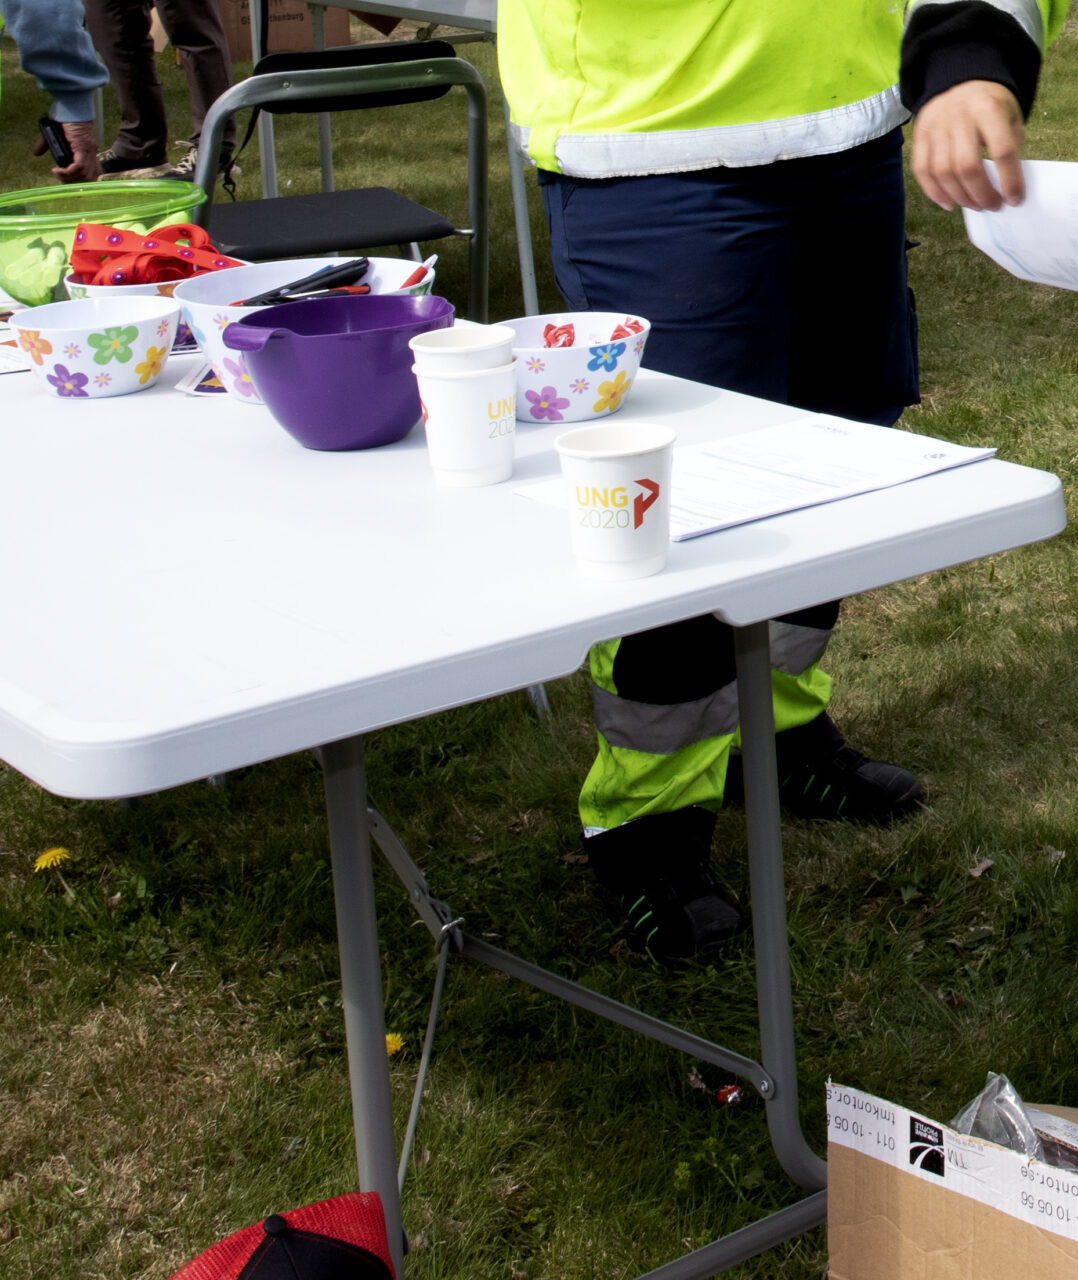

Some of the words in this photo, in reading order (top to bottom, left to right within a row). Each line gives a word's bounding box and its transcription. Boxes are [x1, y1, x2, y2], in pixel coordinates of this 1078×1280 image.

[576, 486, 628, 508] UNG
[578, 509, 630, 529] 2020
[834, 1115, 849, 1132] 05
[852, 1121, 864, 1137] 10
[877, 1131, 895, 1151] 011
[1021, 1191, 1034, 1209] 56
[1038, 1199, 1053, 1216] 05
[1056, 1206, 1071, 1222] 10
